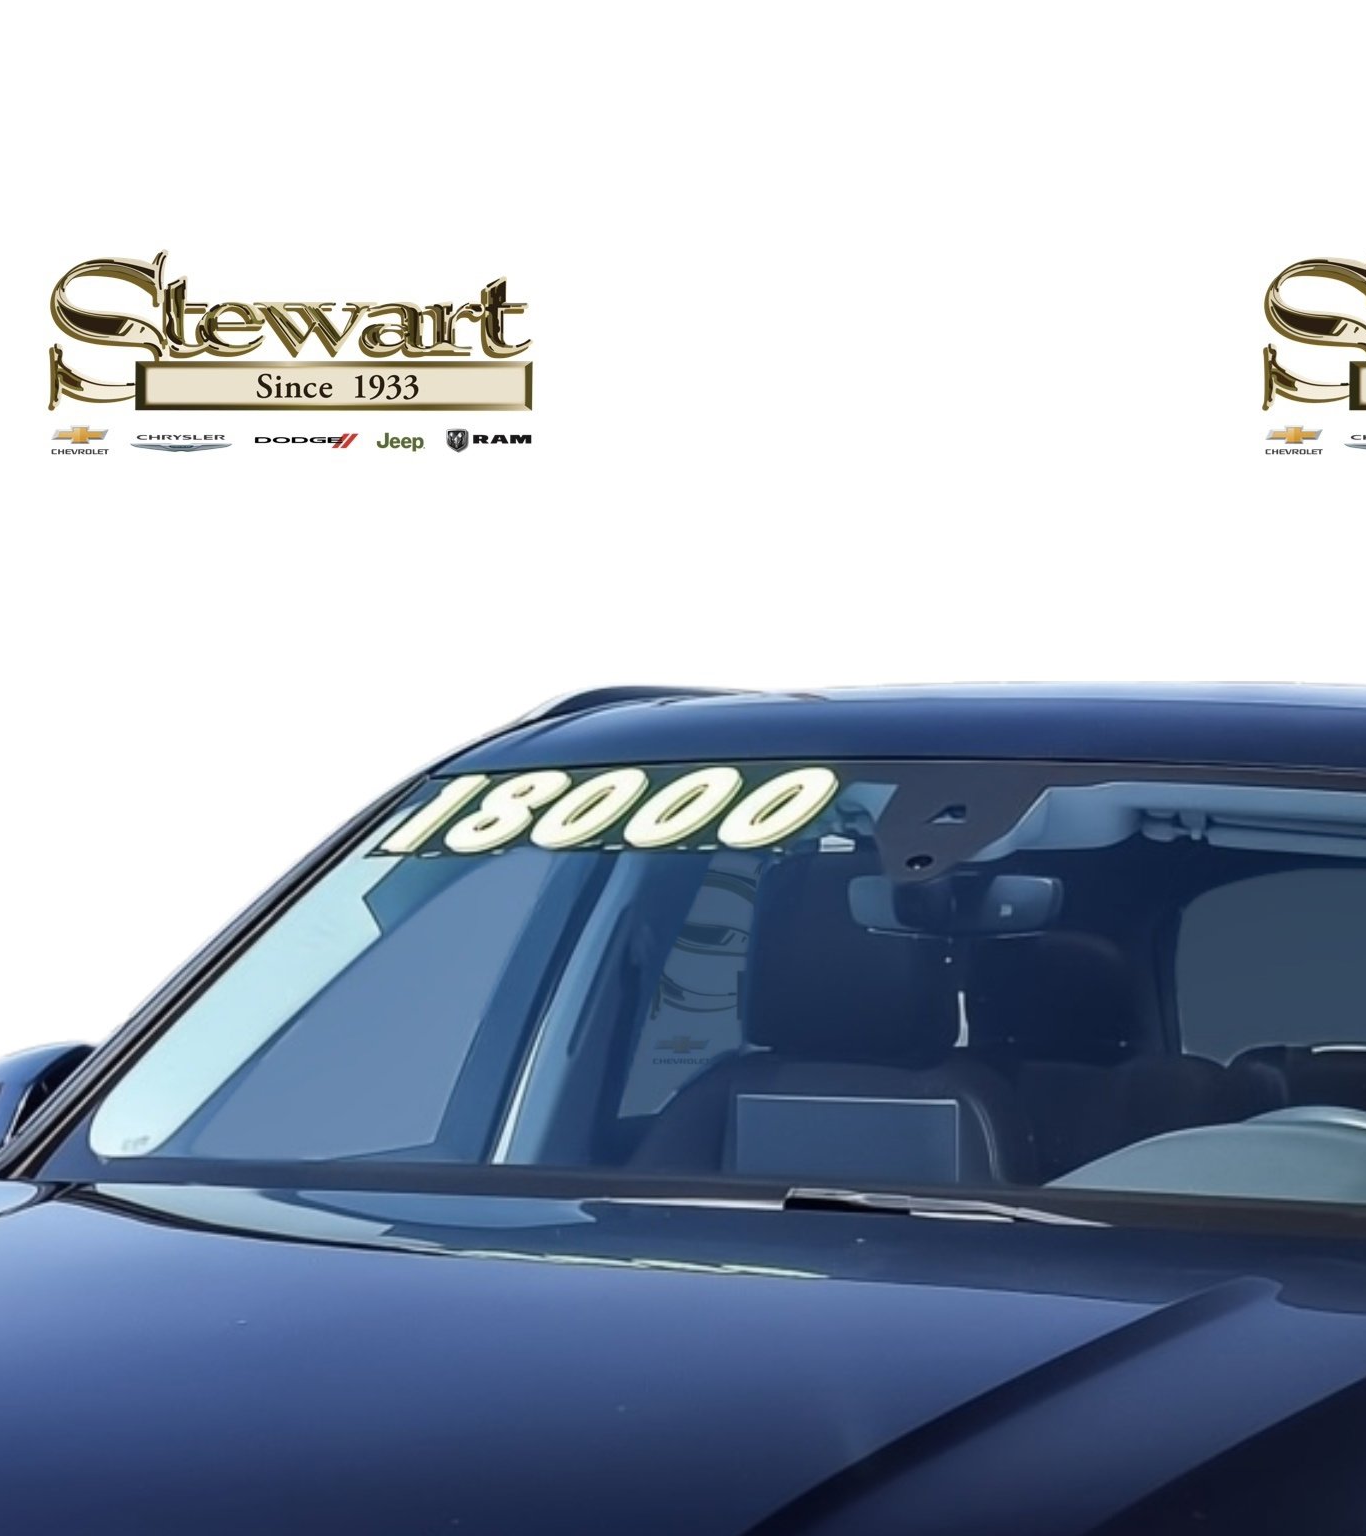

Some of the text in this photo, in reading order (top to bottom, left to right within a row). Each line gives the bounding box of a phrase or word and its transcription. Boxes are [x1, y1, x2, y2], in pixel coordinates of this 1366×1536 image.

[49, 248, 533, 409] Stewart
[256, 373, 419, 400] Since 1933
[254, 435, 342, 444] DODGE
[376, 432, 425, 452] Jeep
[473, 435, 532, 445] RAM
[380, 766, 839, 854] 18000
